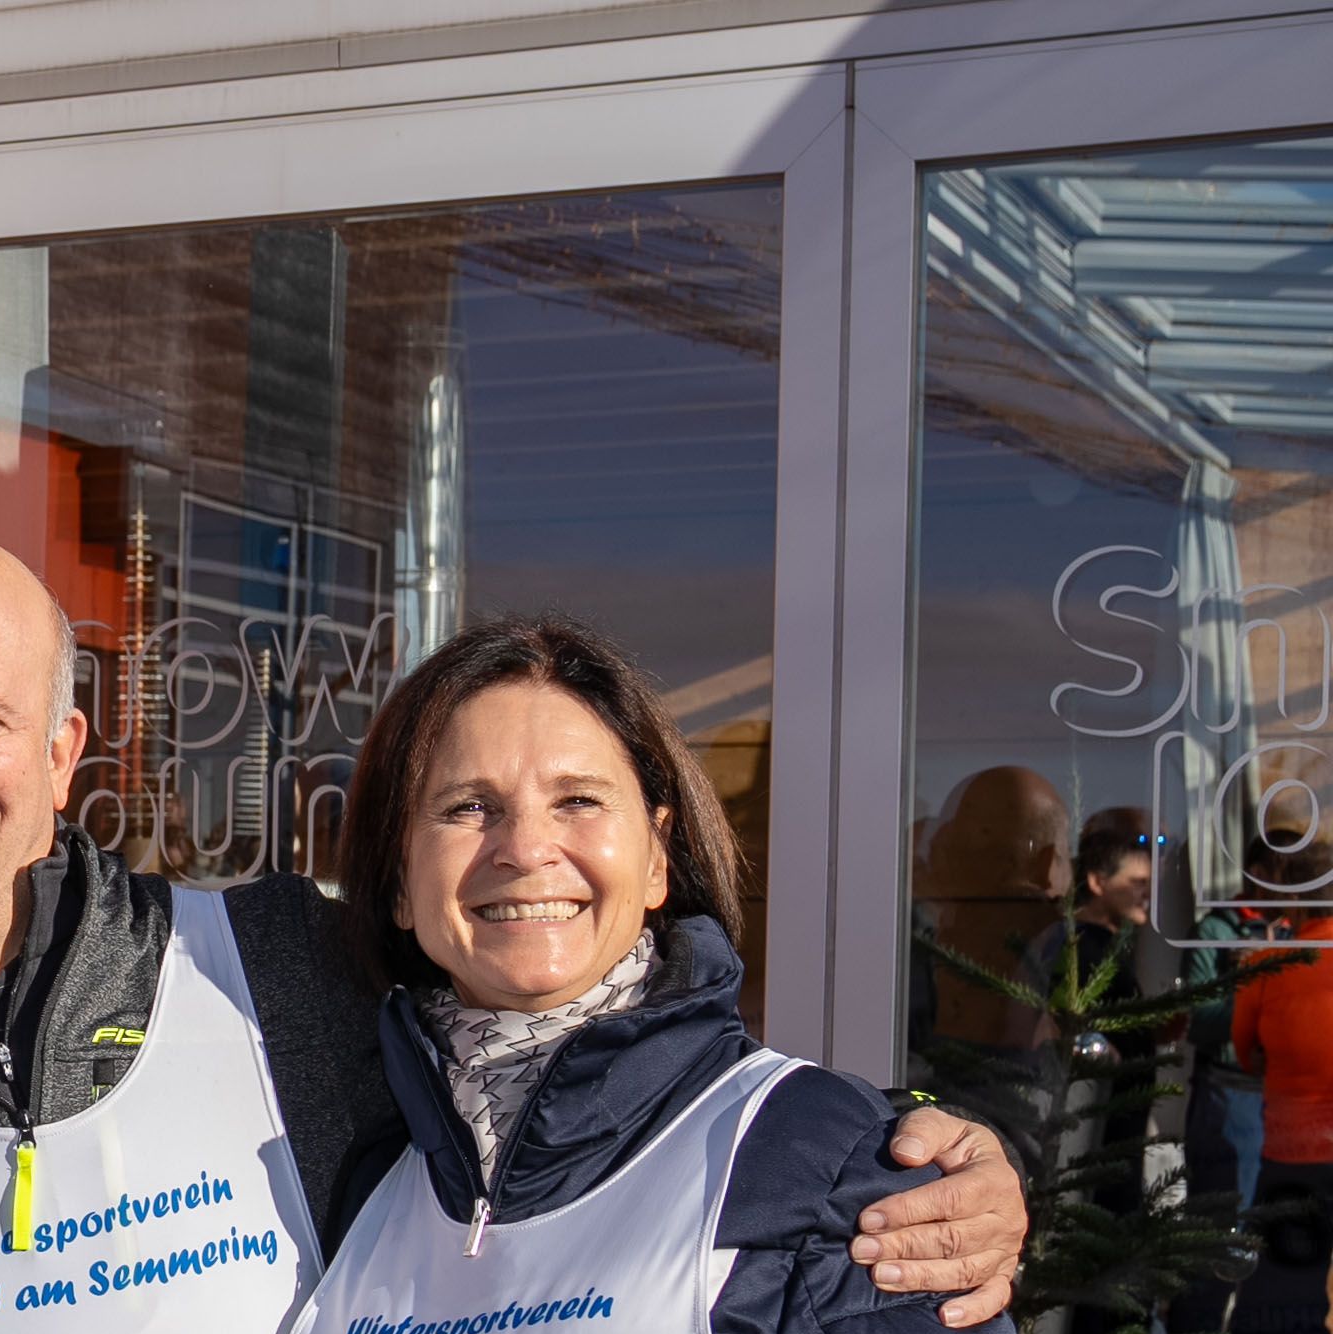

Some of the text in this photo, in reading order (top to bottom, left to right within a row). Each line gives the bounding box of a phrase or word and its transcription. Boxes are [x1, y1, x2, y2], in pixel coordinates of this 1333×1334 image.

[71, 611, 411, 750] now
[14, 1279, 77, 1311] am
[88, 1226, 279, 1297] Semmering
